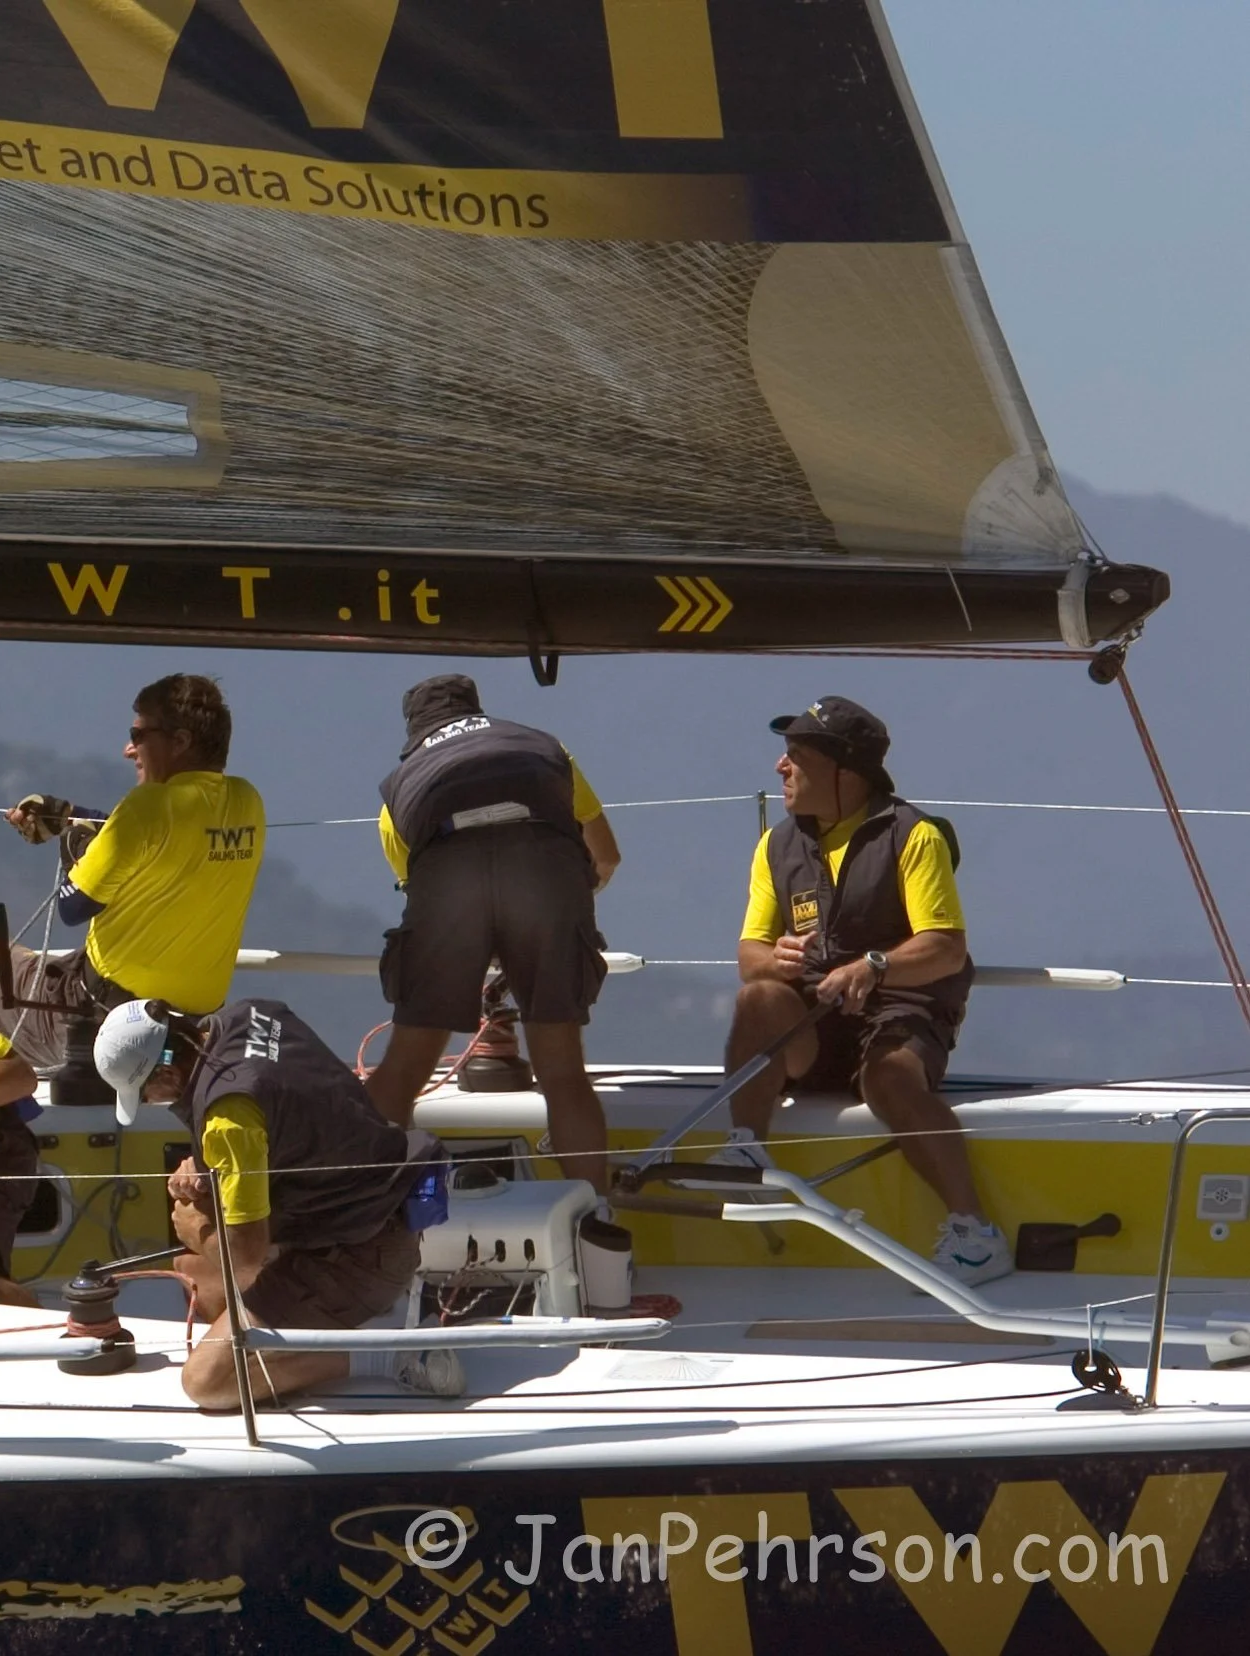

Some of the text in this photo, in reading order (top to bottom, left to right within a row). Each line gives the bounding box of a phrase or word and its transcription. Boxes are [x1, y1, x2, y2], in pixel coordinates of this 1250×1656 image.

[60, 145, 153, 188] and
[169, 149, 291, 203] Data
[306, 164, 550, 230] Solutions
[205, 826, 257, 850] TWT
[244, 1006, 271, 1059] TWT
